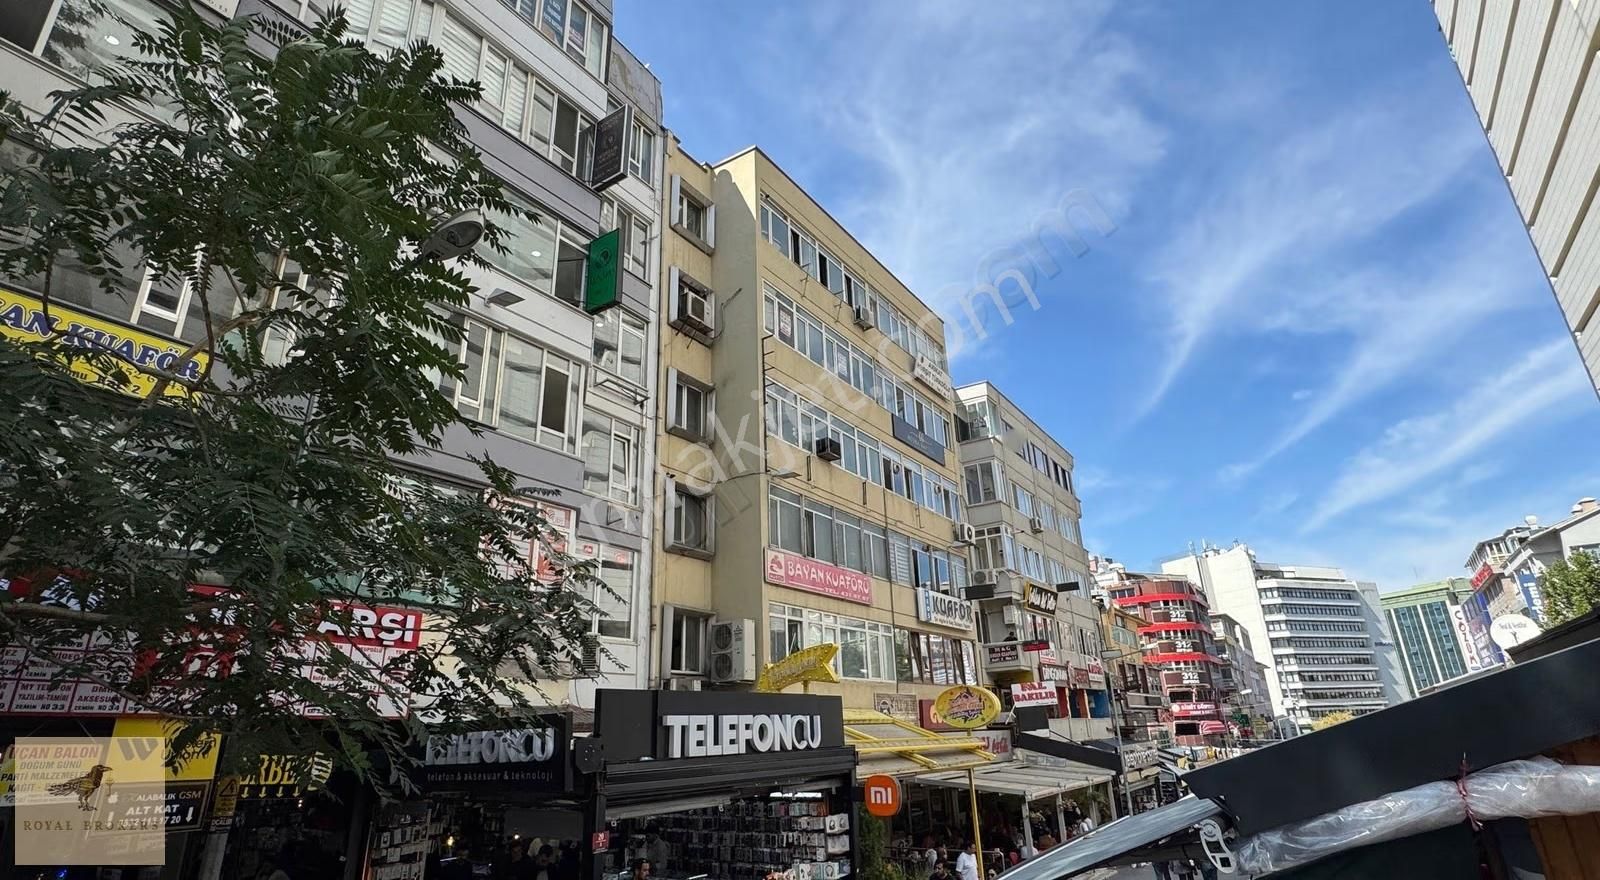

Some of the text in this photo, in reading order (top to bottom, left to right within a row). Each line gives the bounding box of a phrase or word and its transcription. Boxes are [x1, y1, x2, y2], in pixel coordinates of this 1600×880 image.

[0, 297, 61, 338] AN
[788, 560, 825, 583] BAYAN
[1170, 611, 1187, 619] 312
[316, 604, 416, 646] ARŞI
[1176, 641, 1193, 649] 312
[1182, 672, 1199, 680] 312
[1020, 682, 1047, 691] FAL
[1013, 691, 1057, 702] BAKILIR
[663, 714, 822, 758] TELEFONCU
[179, 790, 202, 799] GSM
[126, 804, 180, 816] ALT KAT
